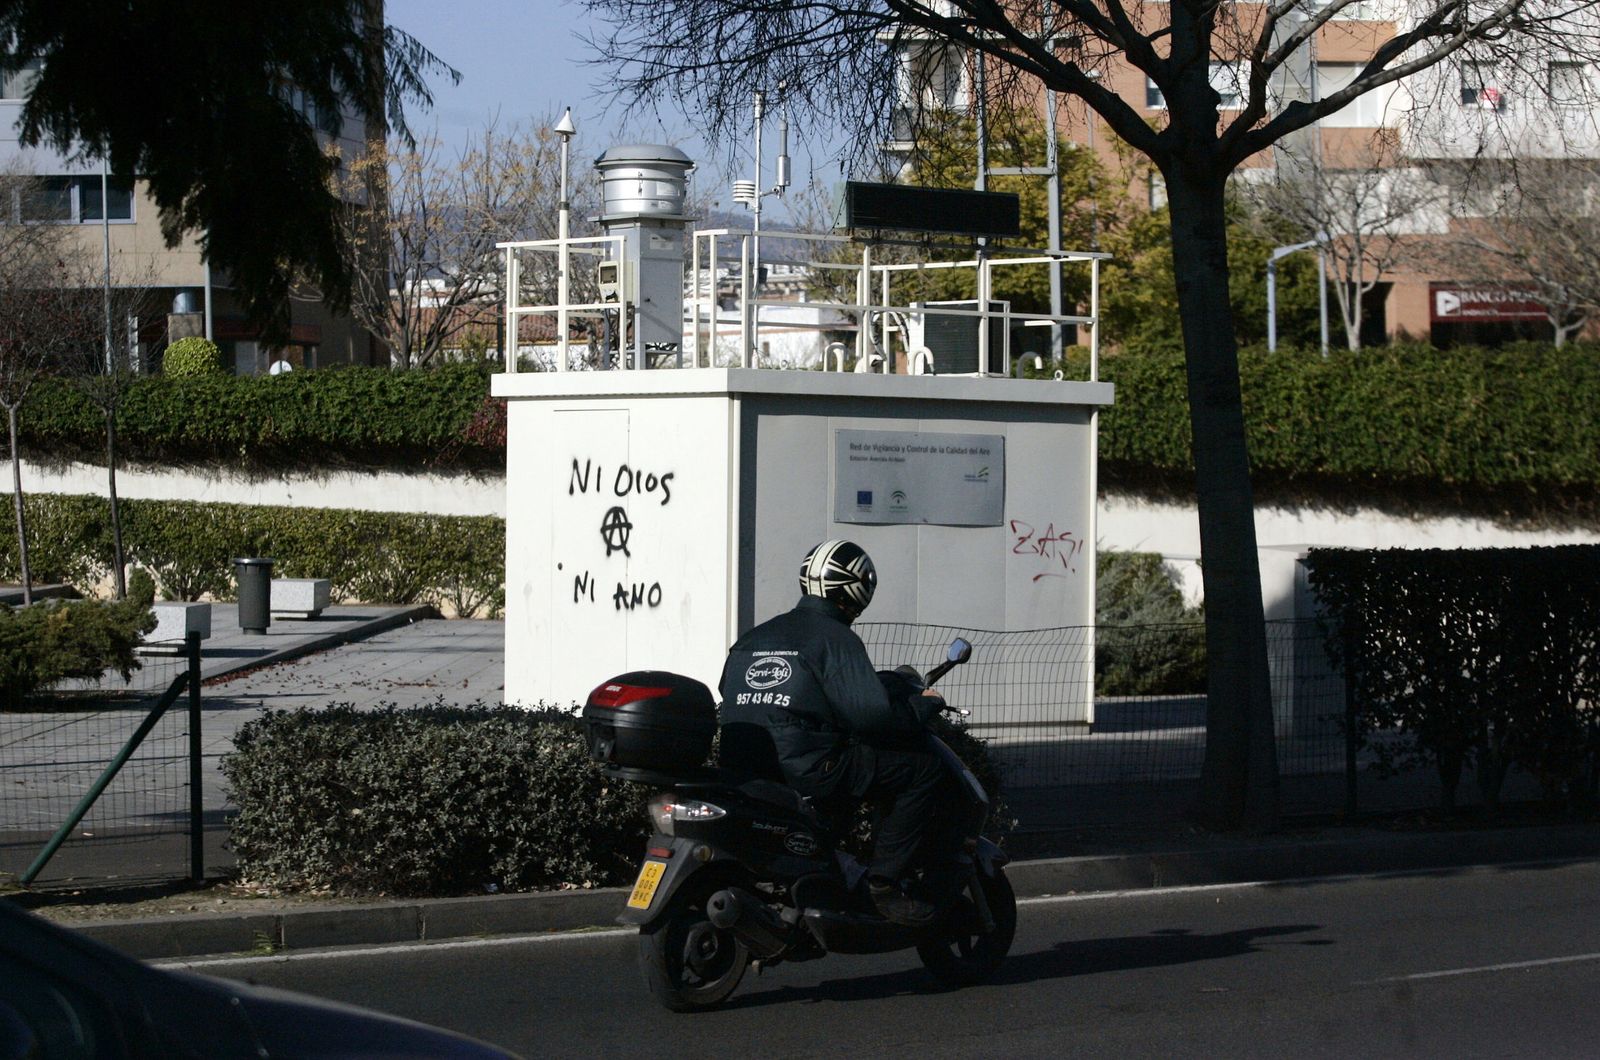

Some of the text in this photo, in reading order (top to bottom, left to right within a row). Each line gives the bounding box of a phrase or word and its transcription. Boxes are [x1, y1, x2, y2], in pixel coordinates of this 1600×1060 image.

[850, 443, 862, 451] Red
[872, 444, 900, 453] Vigilancia
[906, 444, 928, 453] Control
[930, 446, 938, 454] de
[946, 446, 967, 455] Calidad
[968, 447, 978, 455] del
[979, 448, 991, 456] Aire
[569, 458, 602, 496] NI
[574, 570, 595, 604] NI
[736, 692, 791, 707] 957 43 46 25
